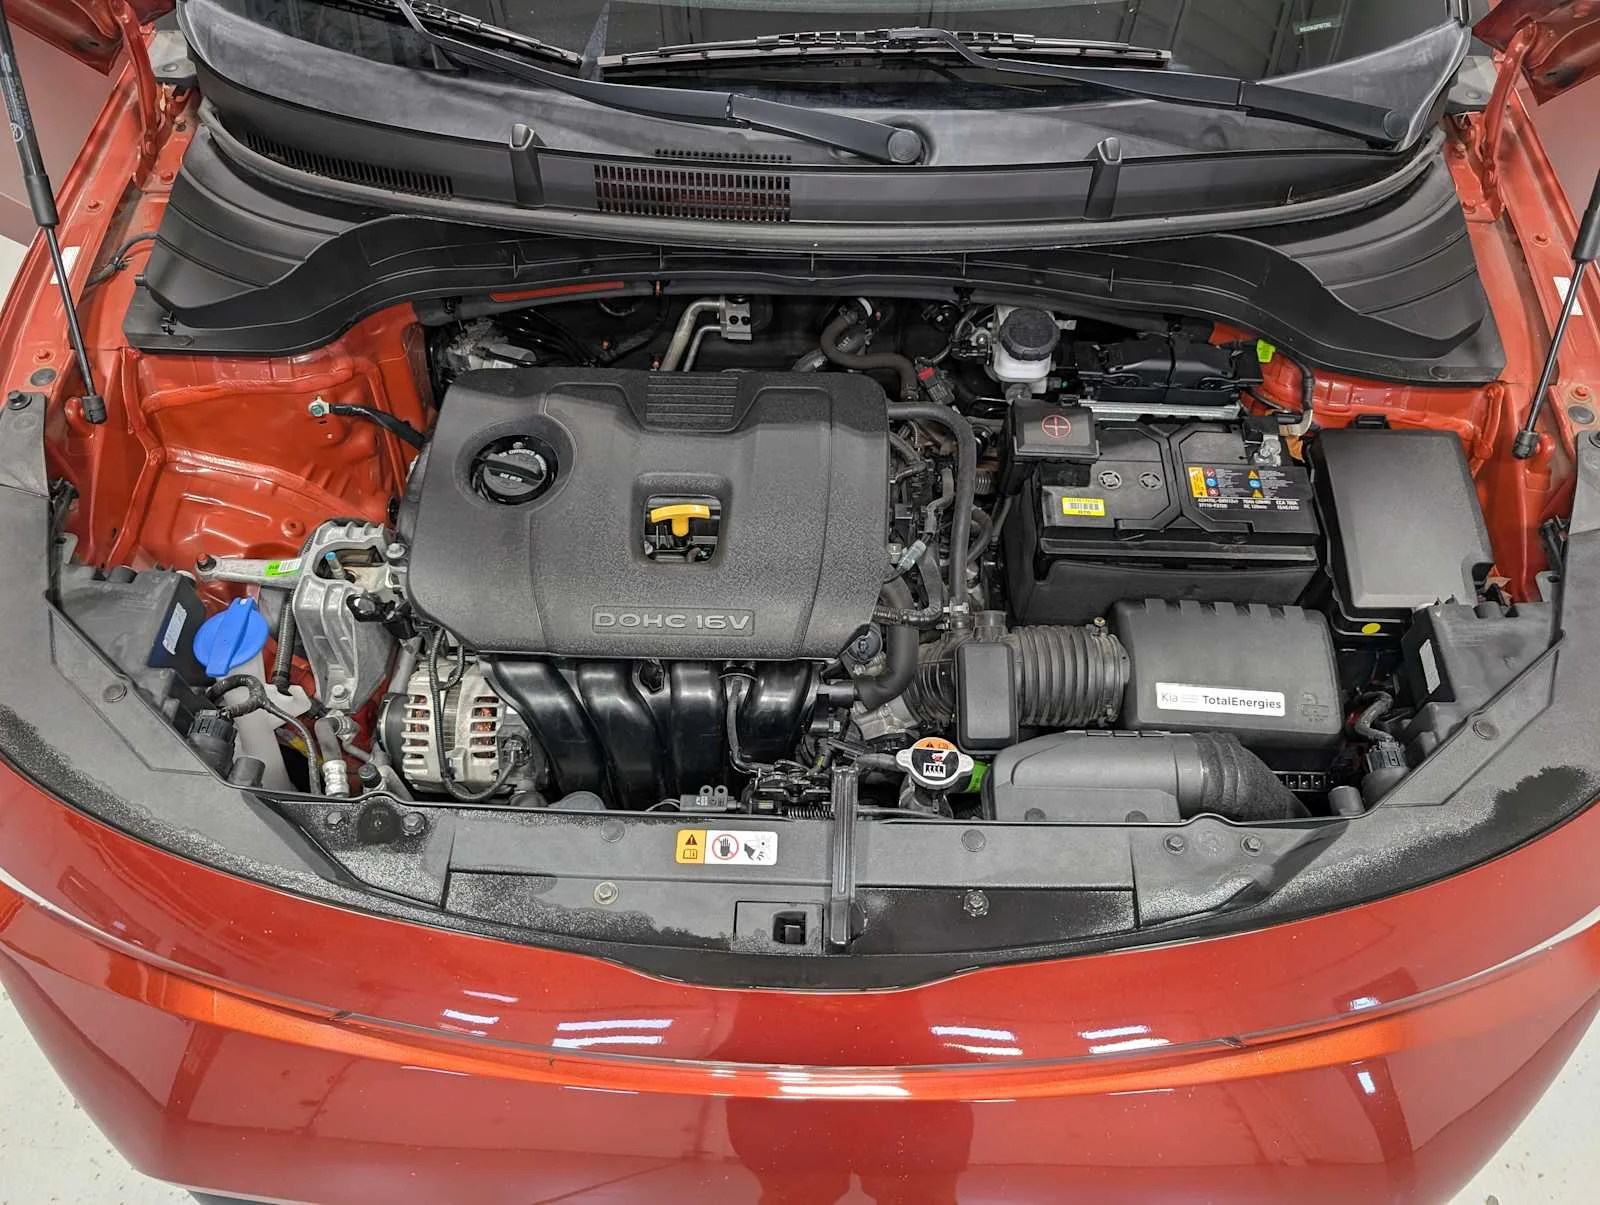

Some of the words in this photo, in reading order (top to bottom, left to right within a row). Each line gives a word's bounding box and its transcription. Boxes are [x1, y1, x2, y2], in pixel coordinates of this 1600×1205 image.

[594, 613, 687, 629] DOHC
[696, 615, 750, 630] 16V
[1161, 692, 1178, 703] Kia
[1202, 695, 1282, 709] TotalEnergies
